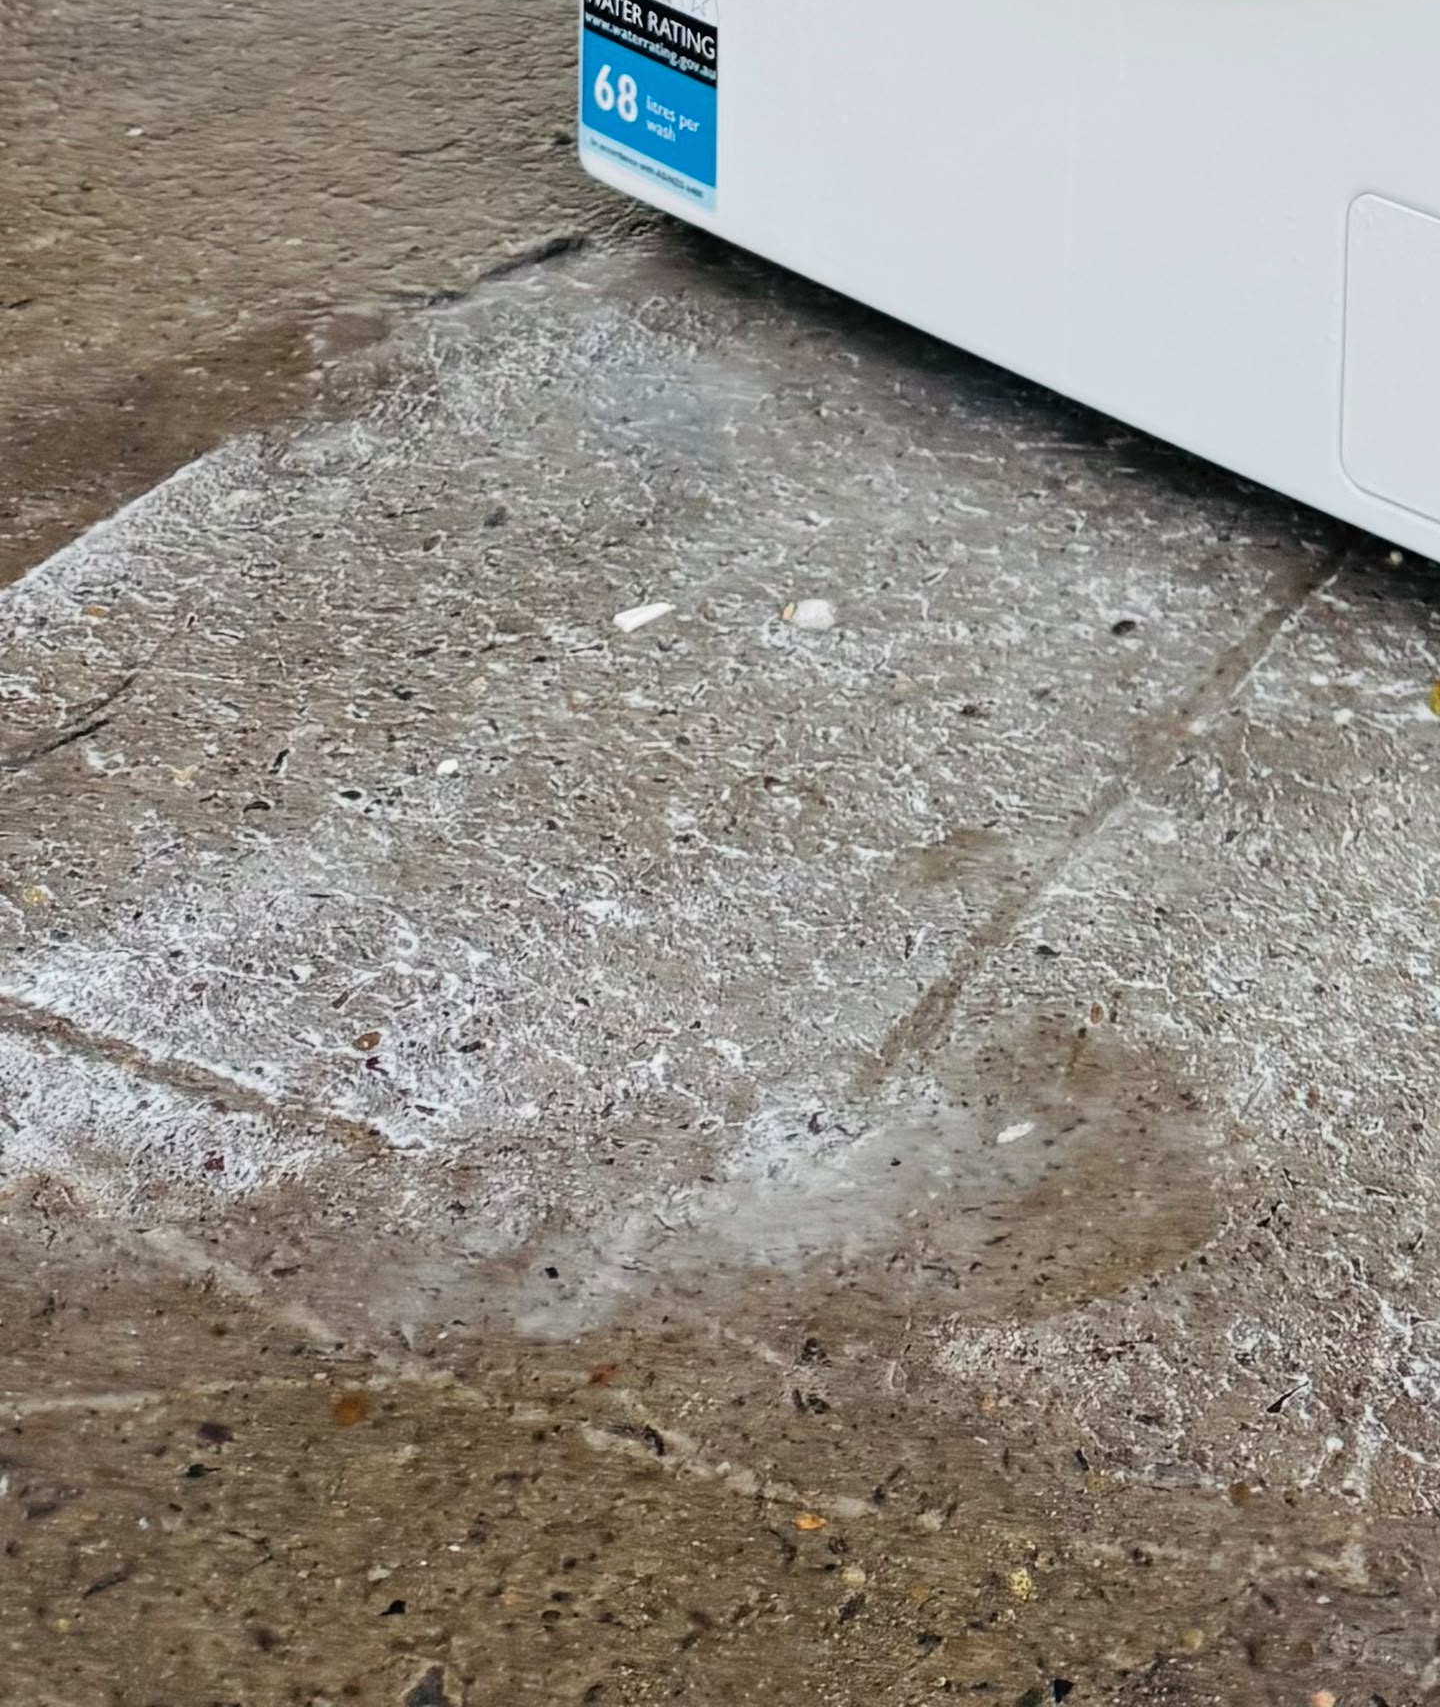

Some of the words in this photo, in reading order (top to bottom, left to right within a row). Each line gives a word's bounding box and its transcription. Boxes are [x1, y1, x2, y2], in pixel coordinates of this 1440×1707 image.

[647, 10, 716, 60] RATING
[594, 64, 638, 122] 68
[646, 94, 676, 123] litres
[679, 114, 700, 132] per
[646, 119, 676, 142] wash
